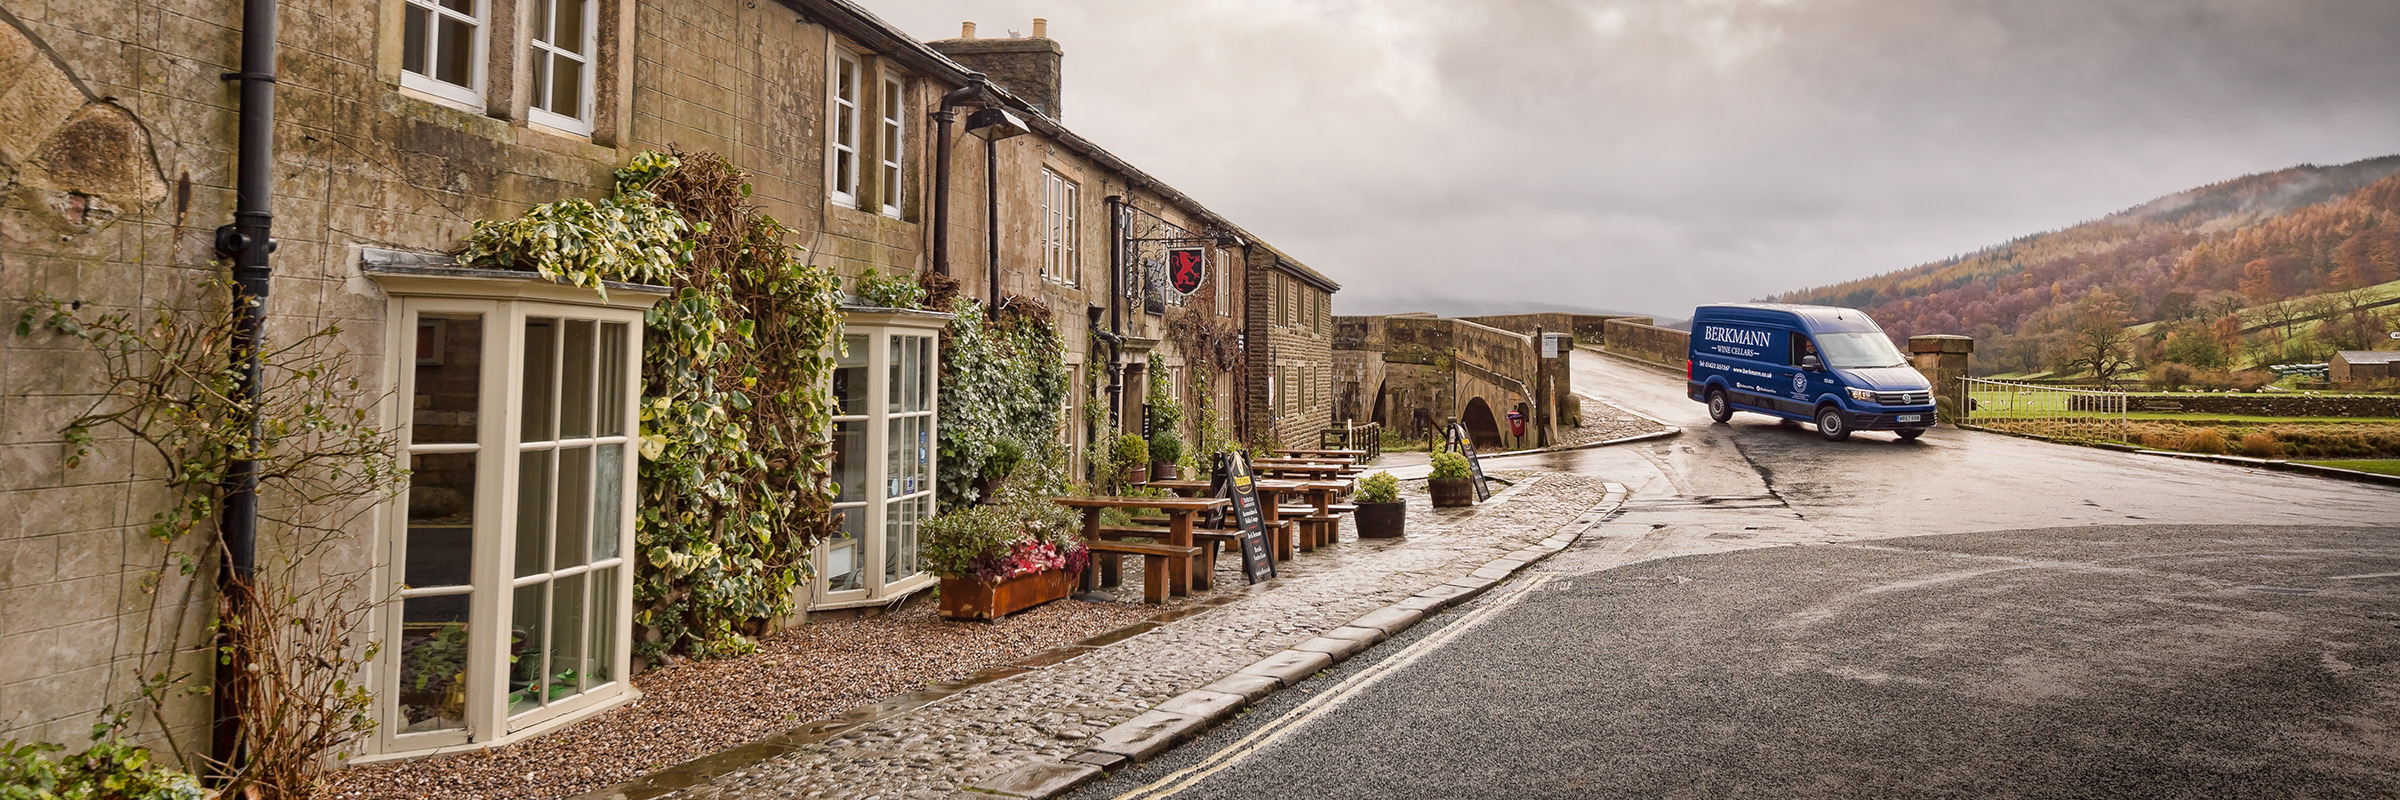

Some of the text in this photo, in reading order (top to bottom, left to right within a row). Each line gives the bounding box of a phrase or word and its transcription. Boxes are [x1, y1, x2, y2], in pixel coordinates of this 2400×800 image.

[1705, 326, 1771, 347] BERKMANN
[1717, 345, 1754, 357] WINE CELLARS
[1733, 367, 1772, 378] www.berkmann.co.uk
